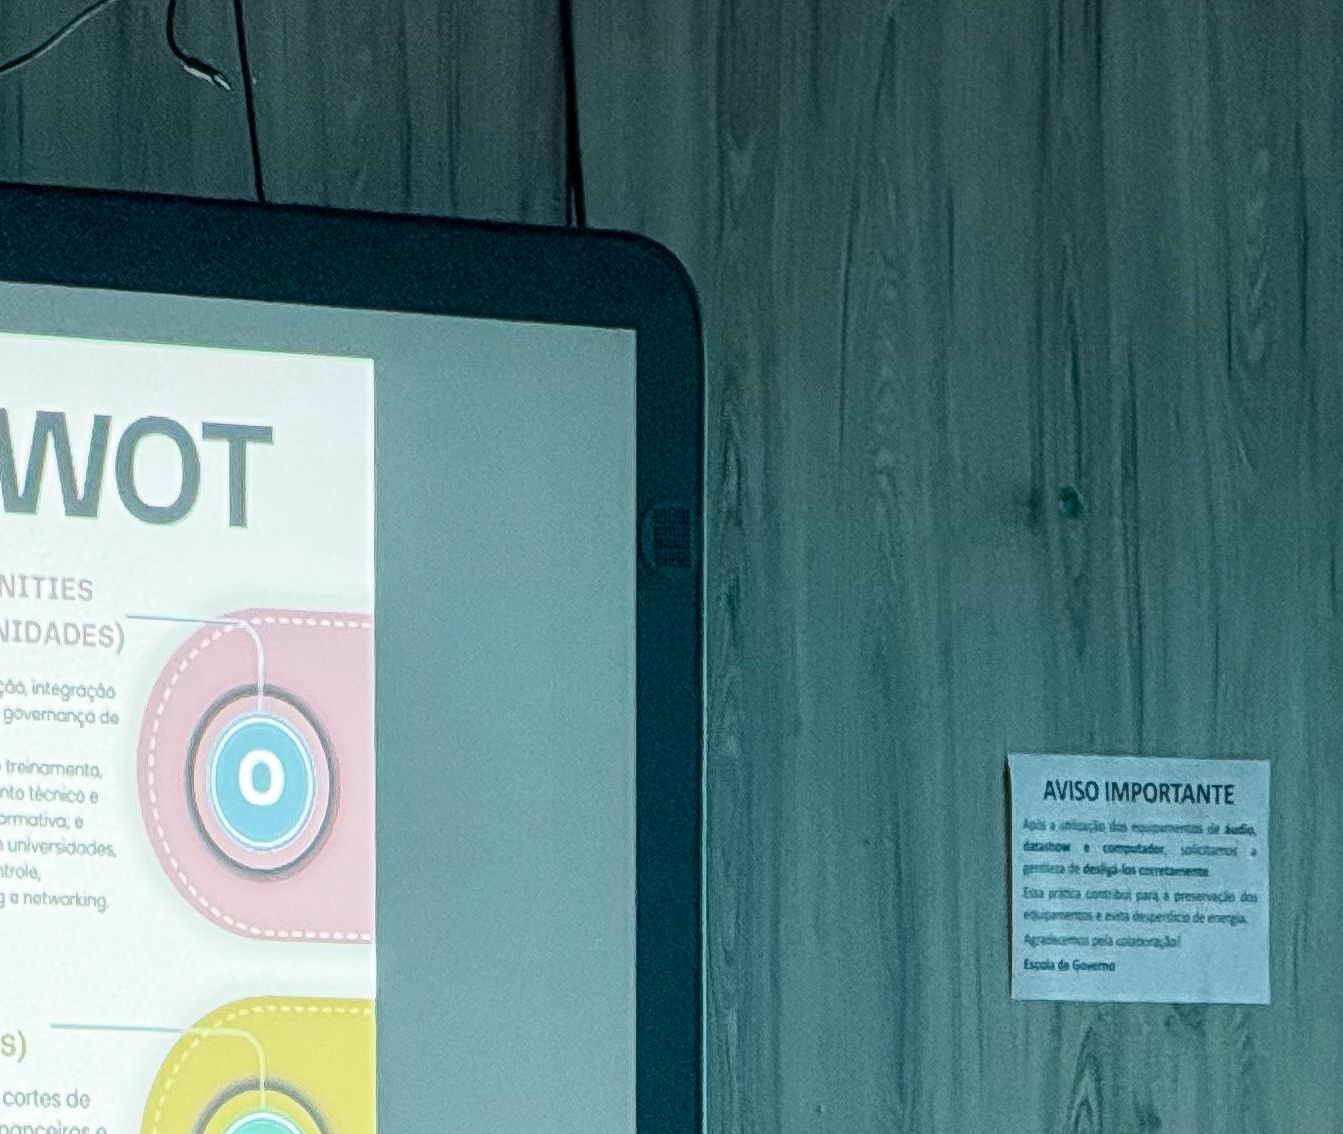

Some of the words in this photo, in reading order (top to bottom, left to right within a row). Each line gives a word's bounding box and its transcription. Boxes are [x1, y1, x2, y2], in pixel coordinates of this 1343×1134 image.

[32, 679, 116, 703] integração
[3, 707, 96, 728] governança
[100, 710, 119, 725] de
[6, 757, 103, 779] treinamento,
[239, 749, 285, 806] O
[29, 784, 85, 804] técnico
[89, 791, 98, 804] e
[1044, 779, 1099, 801] AVISO
[1105, 781, 1234, 805] IMPORTANTE
[75, 817, 83, 829] e
[8, 836, 117, 858] universidades,
[2, 1088, 61, 1109] cortes
[66, 1088, 91, 1110] de
